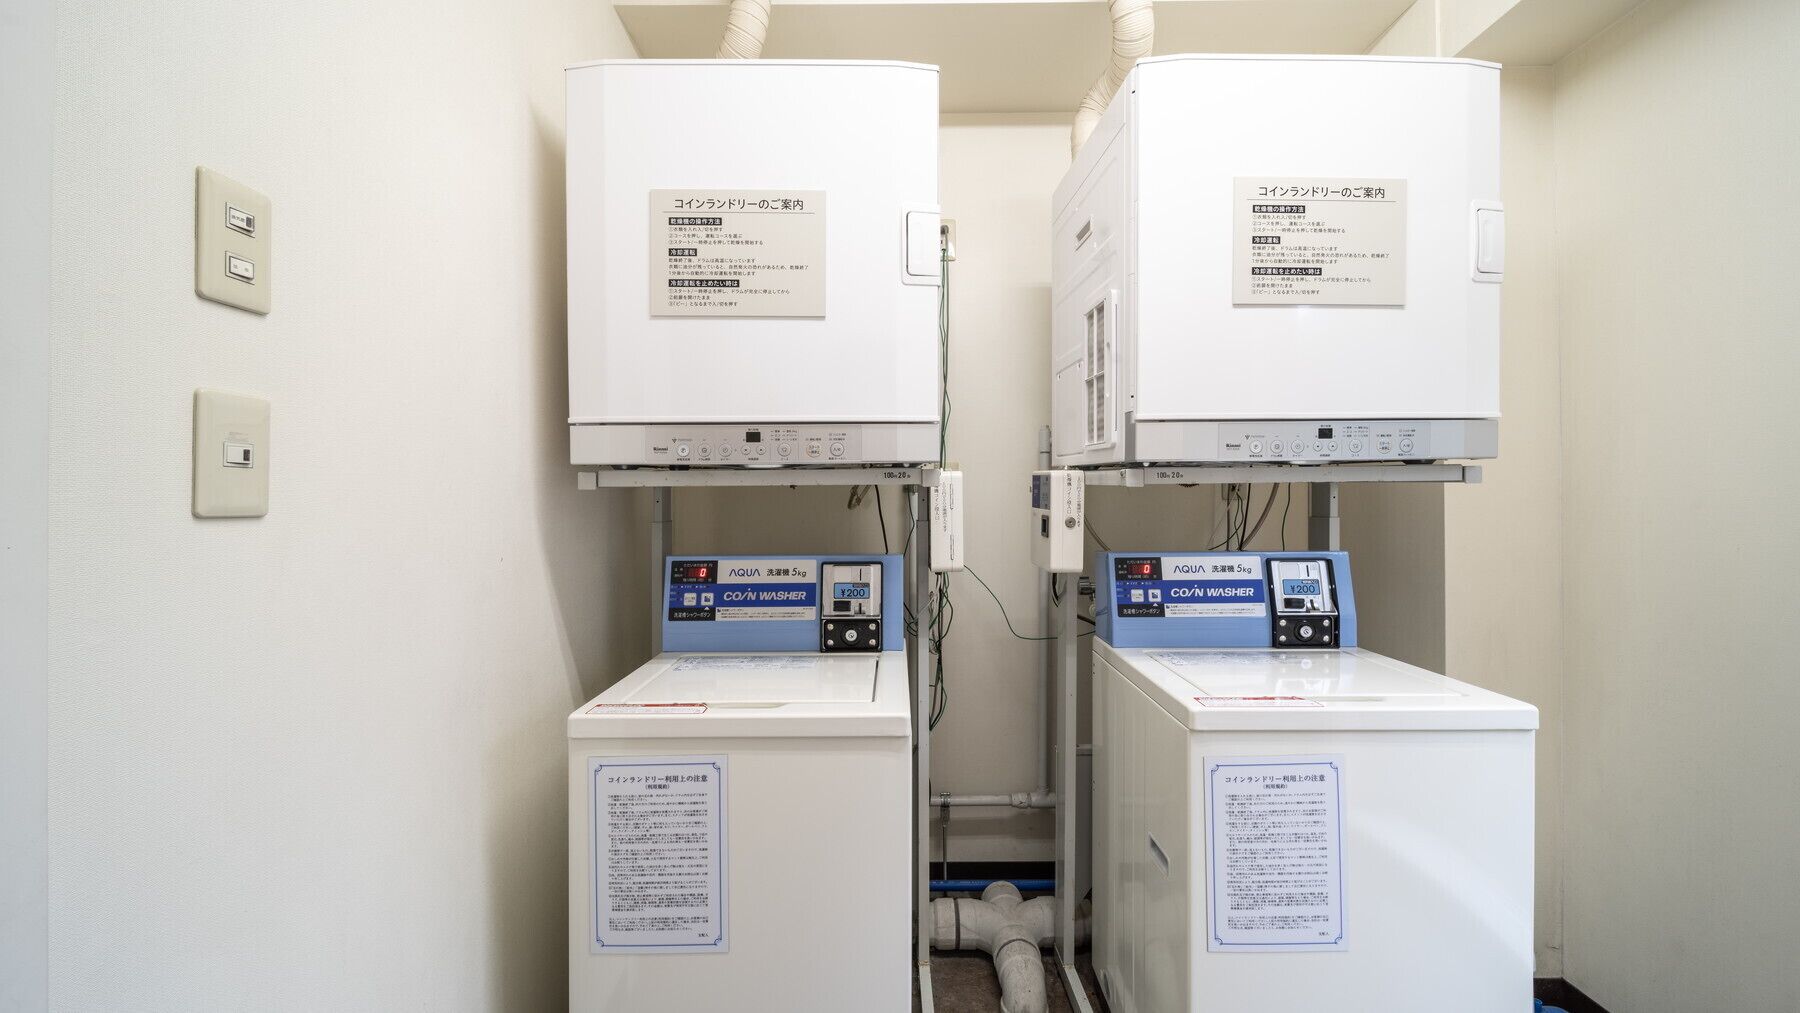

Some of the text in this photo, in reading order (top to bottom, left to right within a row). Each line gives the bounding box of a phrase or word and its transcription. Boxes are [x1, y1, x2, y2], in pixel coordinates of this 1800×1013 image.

[1258, 186, 1386, 199] コインランドリーのご案内
[674, 198, 804, 211] コインランドリーのご案内
[1253, 236, 1280, 244] 冷却運転
[699, 568, 707, 577] 0
[729, 567, 807, 578] AQUA 洗濯機 5kg
[1143, 564, 1150, 574] 0
[1173, 563, 1252, 575] AQUA 洗濯機 5kg
[840, 588, 866, 597] ¥200
[1207, 587, 1254, 597] WASHER
[1290, 584, 1316, 594] ¥200
[759, 591, 807, 600] WASHER
[608, 774, 708, 783] コインランドリー利用上の注意
[1225, 774, 1326, 783] コインランドリー利用上の注意
